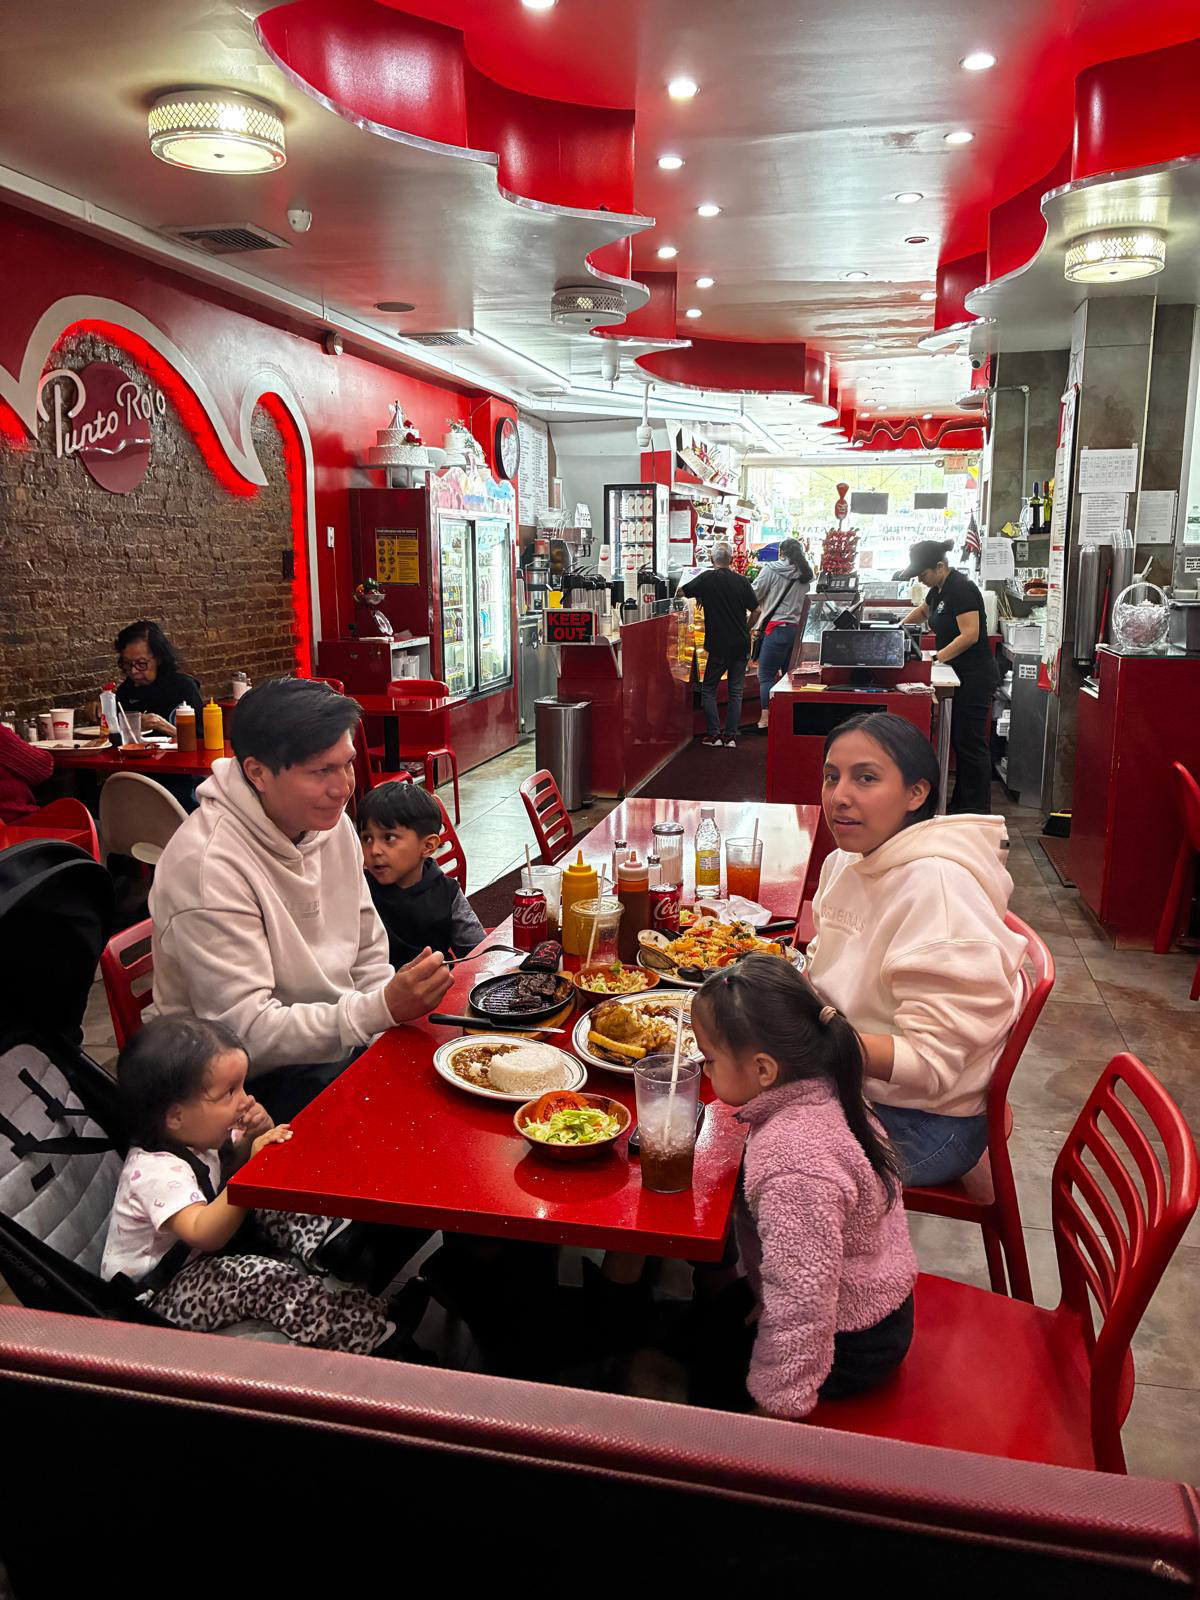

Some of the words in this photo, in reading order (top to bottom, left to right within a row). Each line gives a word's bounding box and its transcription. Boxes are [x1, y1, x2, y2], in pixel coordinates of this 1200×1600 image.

[37, 368, 119, 459] Punto
[116, 381, 166, 426] Rojo
[548, 613, 591, 625] KEEP
[553, 627, 586, 640] OUT
